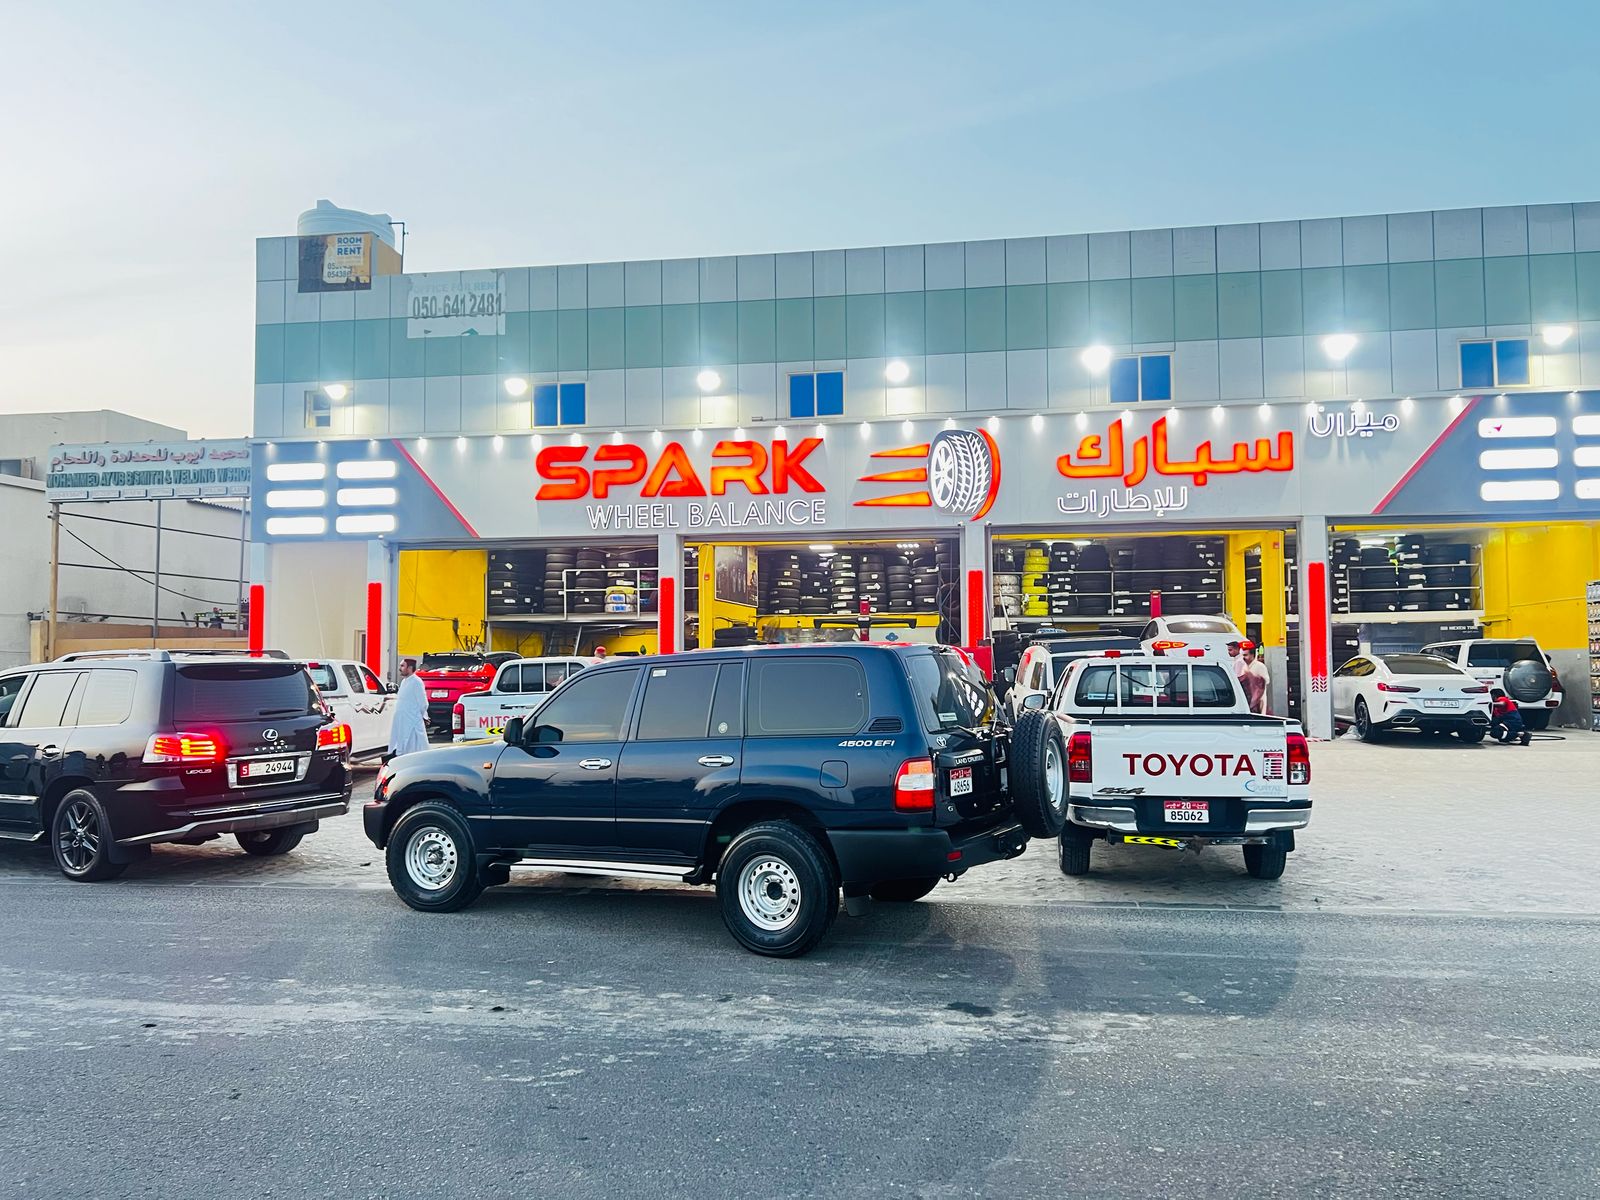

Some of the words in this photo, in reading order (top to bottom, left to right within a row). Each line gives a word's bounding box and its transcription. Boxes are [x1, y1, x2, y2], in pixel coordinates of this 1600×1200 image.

[336, 246, 362, 256] RENT
[1308, 406, 1400, 438] ميزان
[1056, 416, 1294, 488] سبارك
[47, 472, 100, 488] MOHAMMED
[101, 471, 125, 486] AYUB
[164, 470, 172, 485] &
[173, 468, 216, 484] WELDING
[535, 437, 826, 500] SPARK
[1057, 486, 1188, 518] للإطارات
[586, 503, 679, 529] WHEEL
[688, 500, 826, 527] BALANCE
[265, 761, 293, 773] 24944
[1122, 753, 1257, 776] TOYOTA
[1170, 811, 1203, 821] 85062
[1181, 802, 1191, 810] 20
